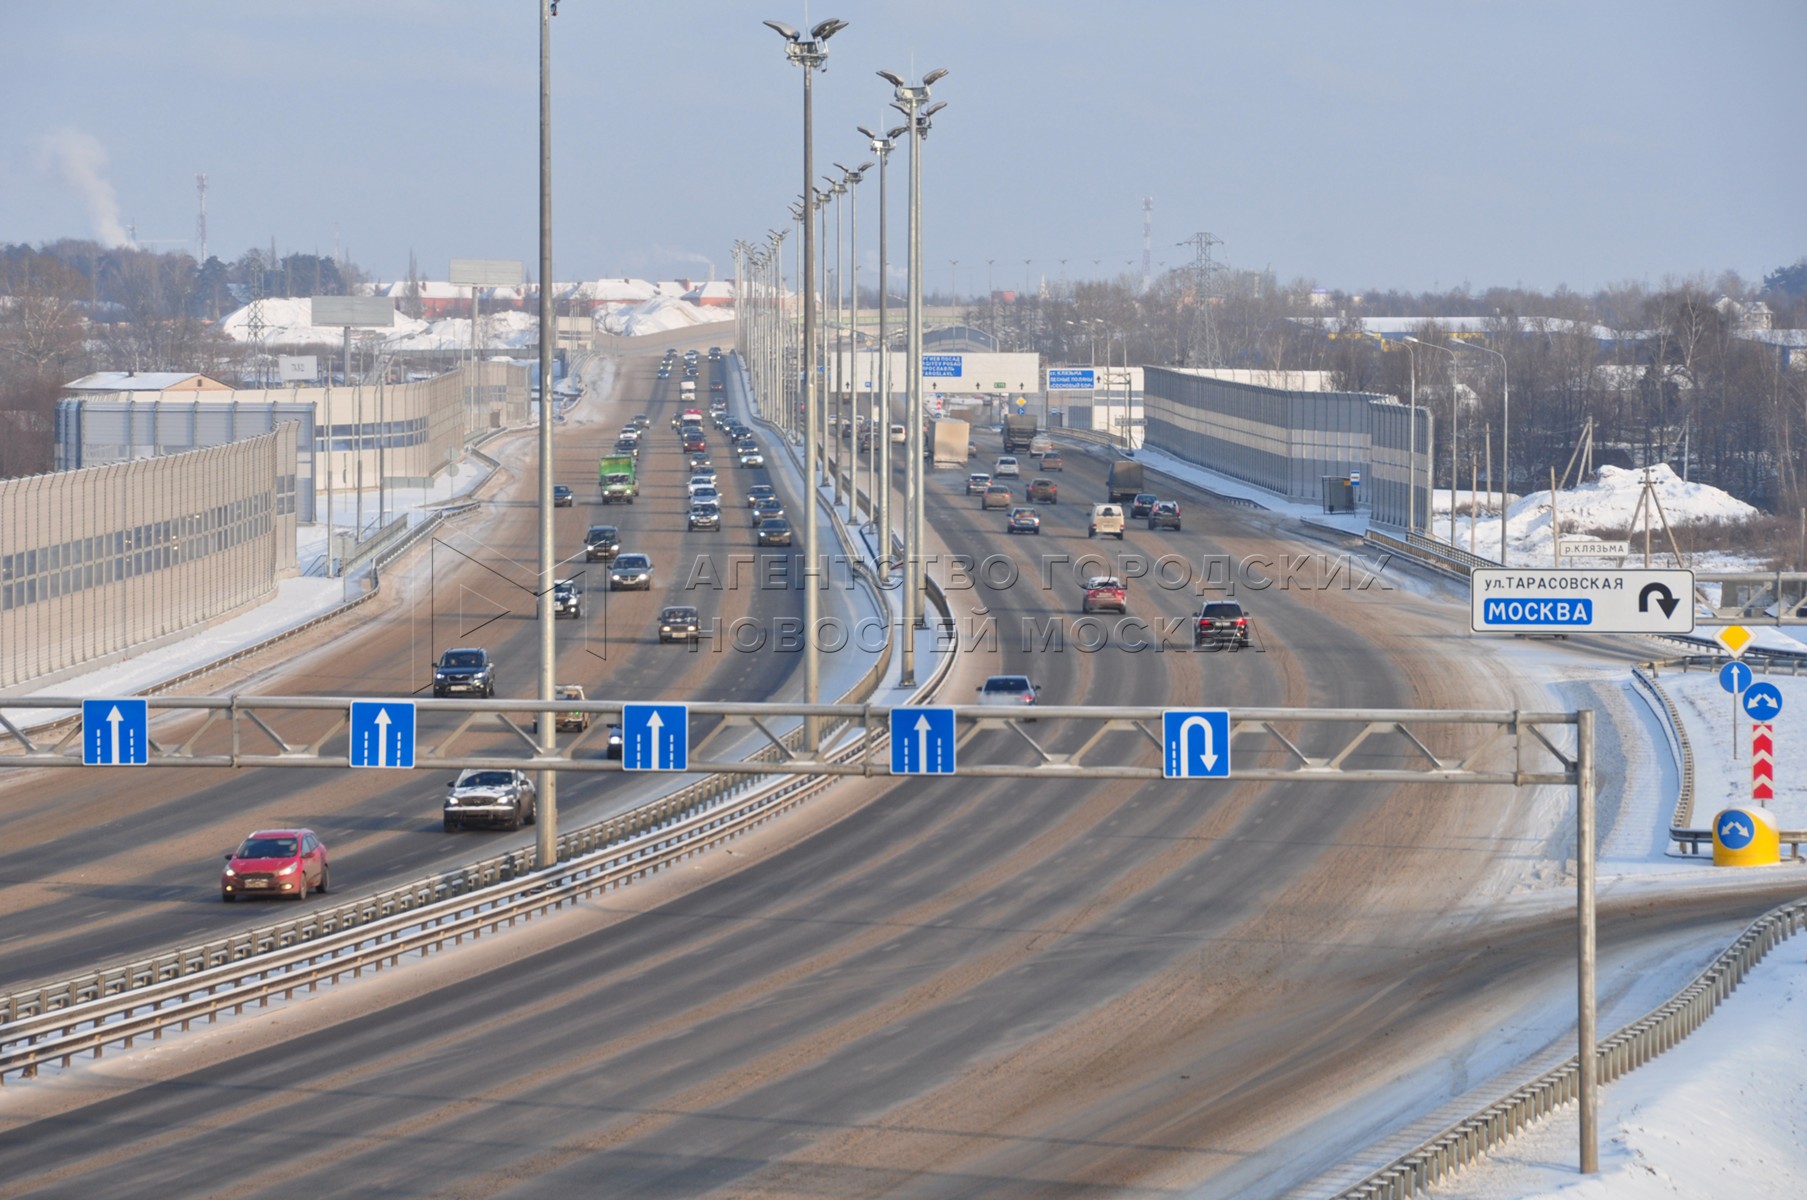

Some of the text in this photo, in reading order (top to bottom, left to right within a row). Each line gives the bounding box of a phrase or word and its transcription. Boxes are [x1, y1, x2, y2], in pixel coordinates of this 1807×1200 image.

[1565, 545, 1624, 555] р.КЛЯЗЬМА
[1484, 577, 1624, 591] ул.ТАРАСОВСКАЯ
[1488, 602, 1588, 621] МОСКВА
